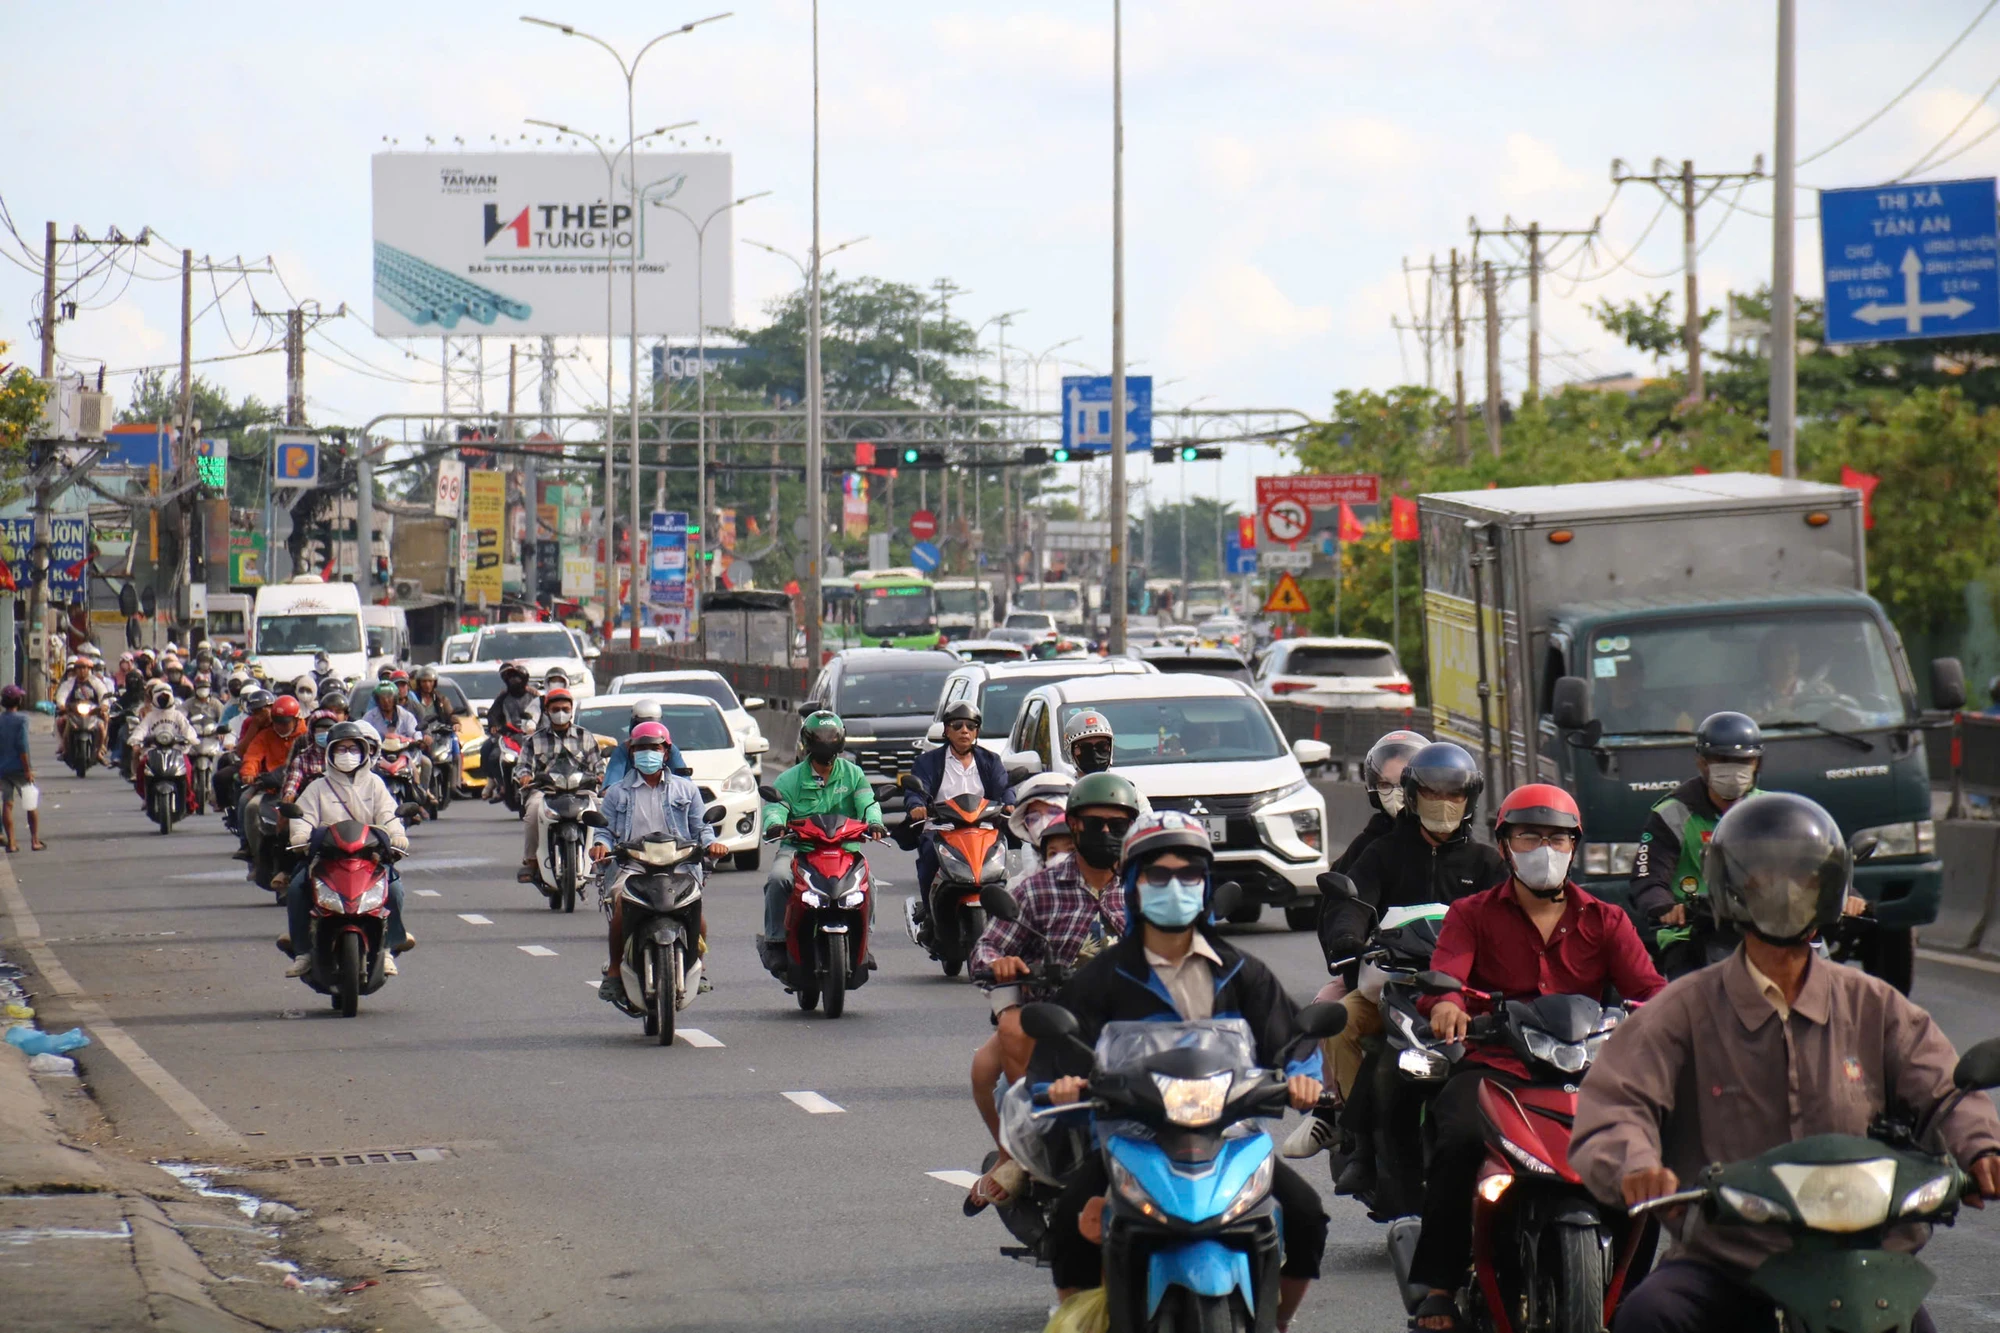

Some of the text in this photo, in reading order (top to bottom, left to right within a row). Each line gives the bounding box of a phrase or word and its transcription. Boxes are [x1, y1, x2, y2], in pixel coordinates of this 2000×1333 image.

[441, 175, 498, 186] TAIWAN
[538, 199, 632, 229] THÉP
[1871, 215, 1951, 237] TÂN AN
[535, 231, 632, 248] TUNG HO
[1628, 780, 1681, 791] THACO
